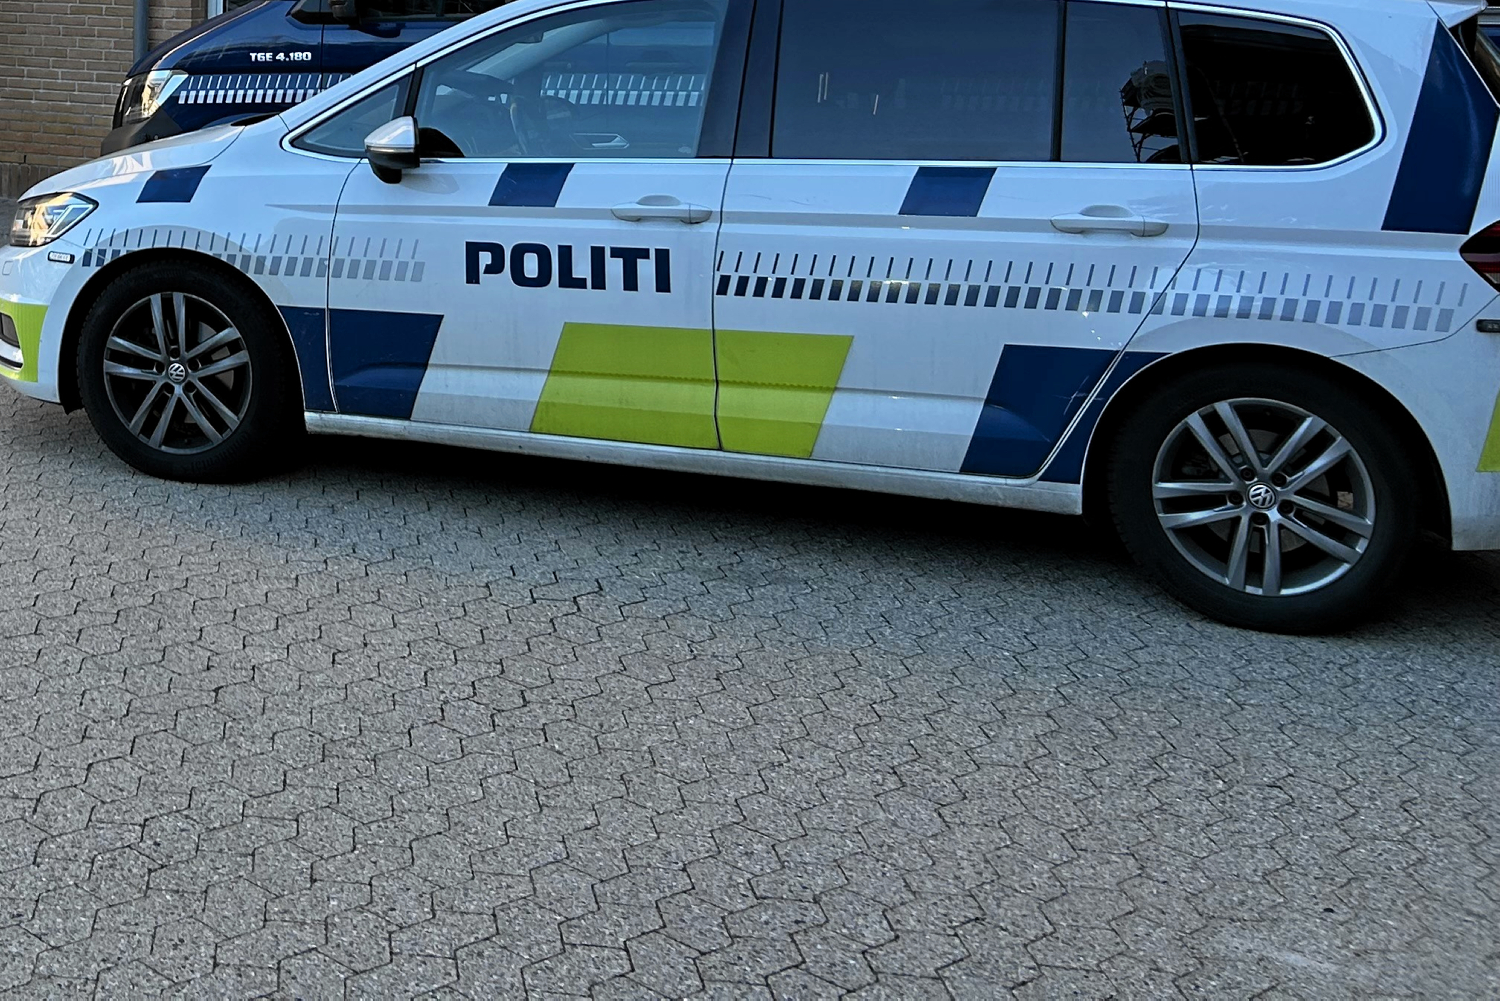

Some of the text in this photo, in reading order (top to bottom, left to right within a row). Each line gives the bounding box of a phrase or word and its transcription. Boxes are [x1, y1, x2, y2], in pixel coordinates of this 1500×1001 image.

[249, 51, 312, 62] TGE 4.180
[465, 240, 672, 294] POLITI
